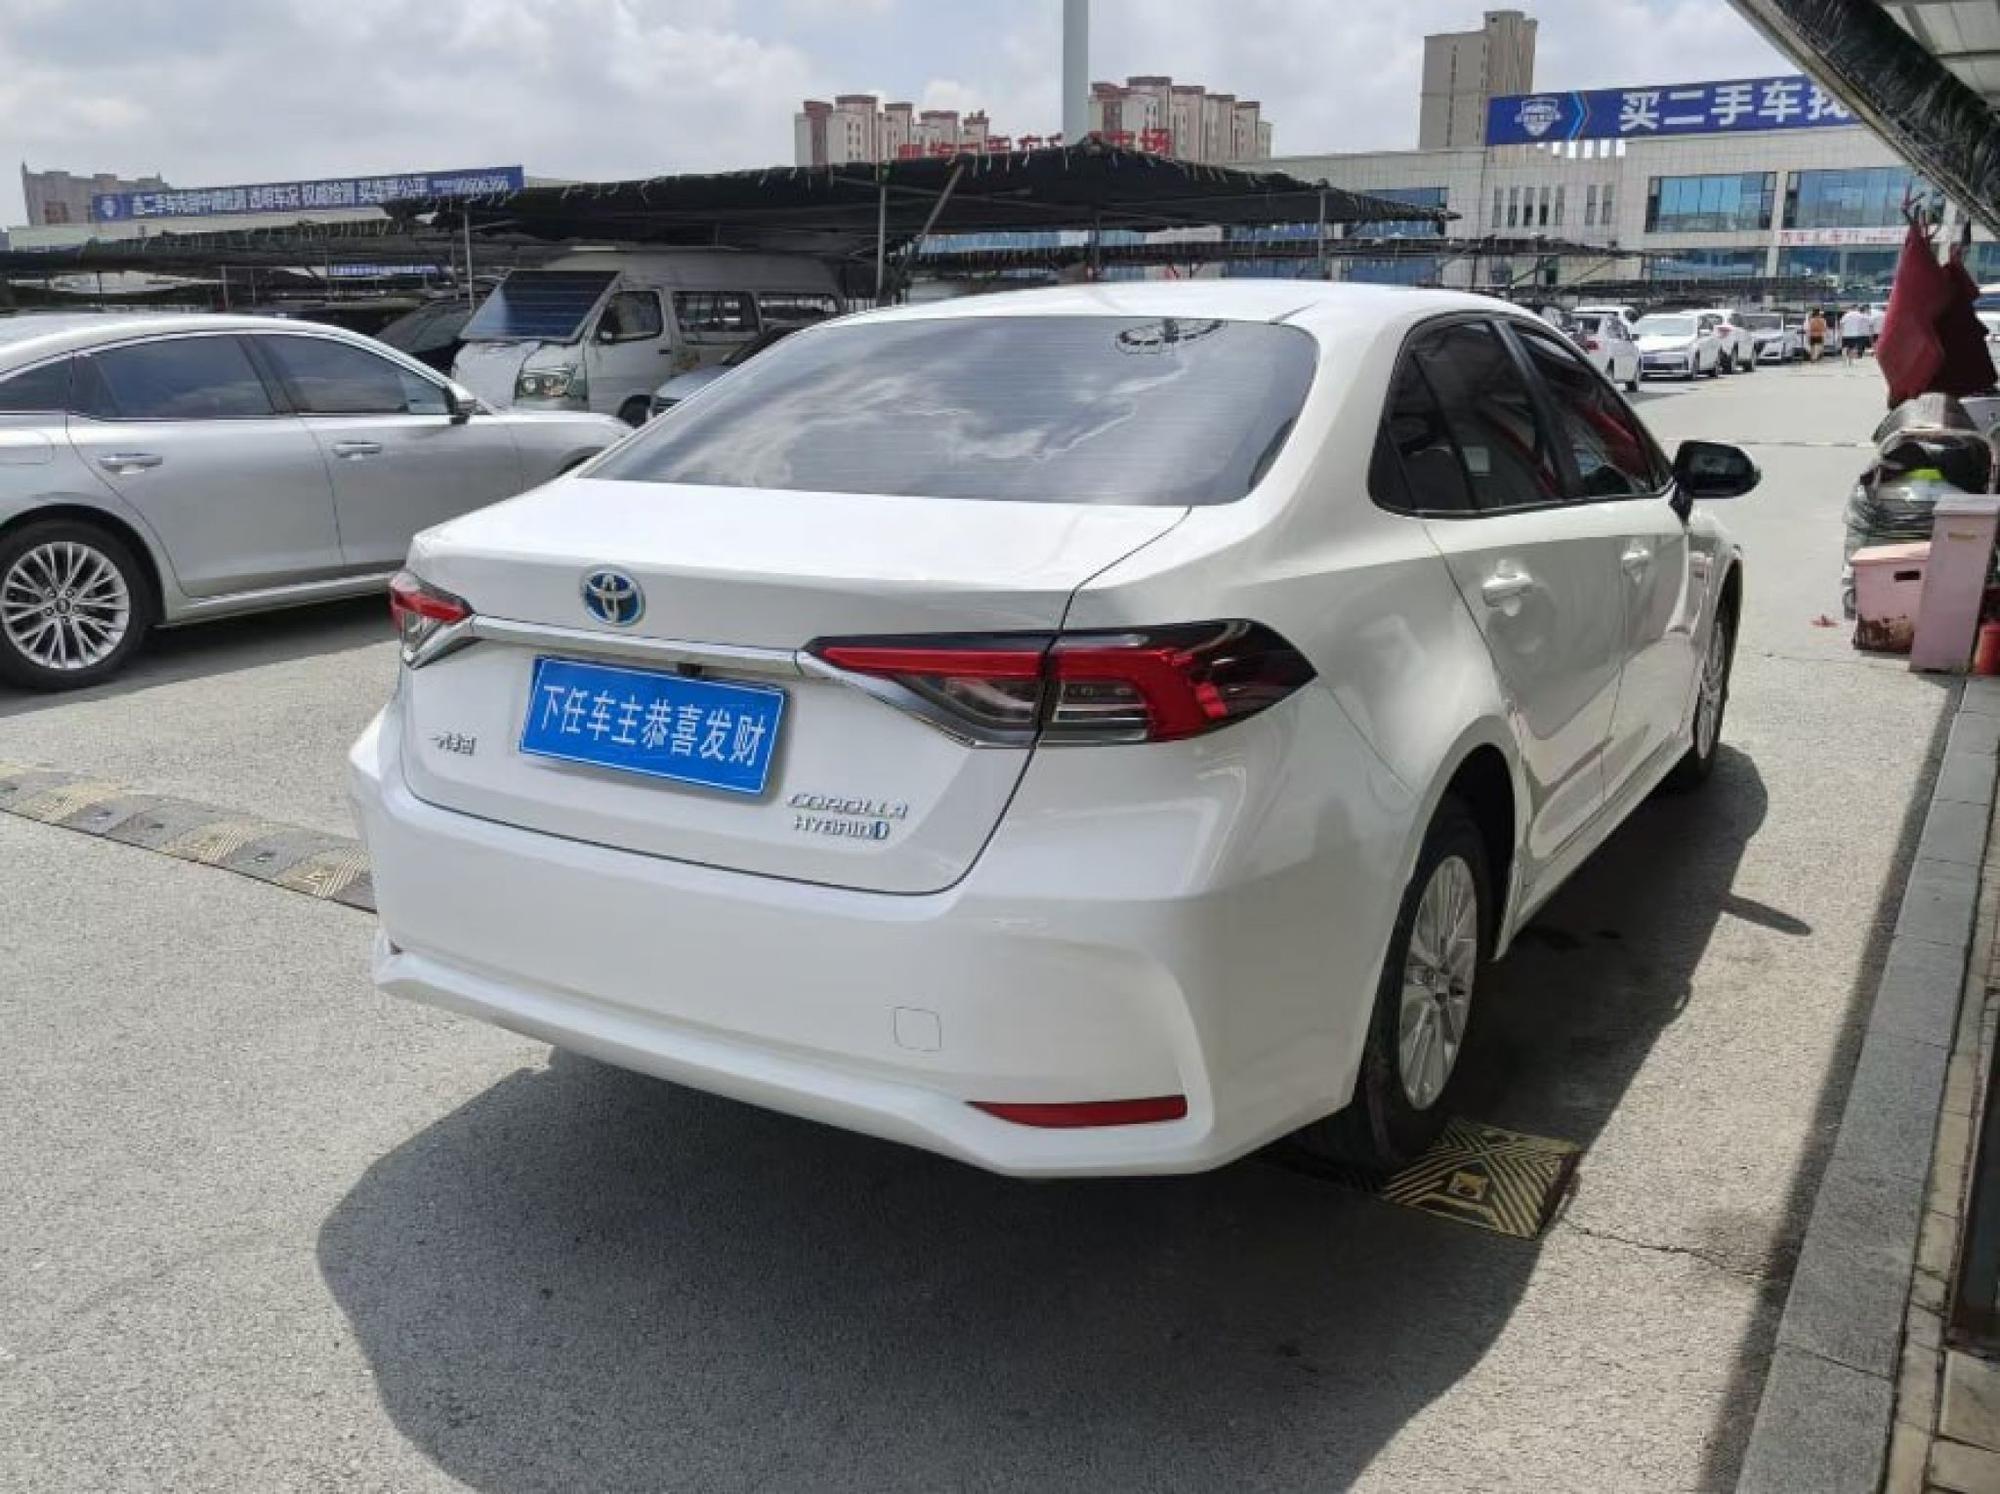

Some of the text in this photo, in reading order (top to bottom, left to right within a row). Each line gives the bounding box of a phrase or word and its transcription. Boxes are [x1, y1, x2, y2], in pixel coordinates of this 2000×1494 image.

[542, 683, 767, 768] 下任车主恭喜发财
[787, 793, 908, 820] COROLLA
